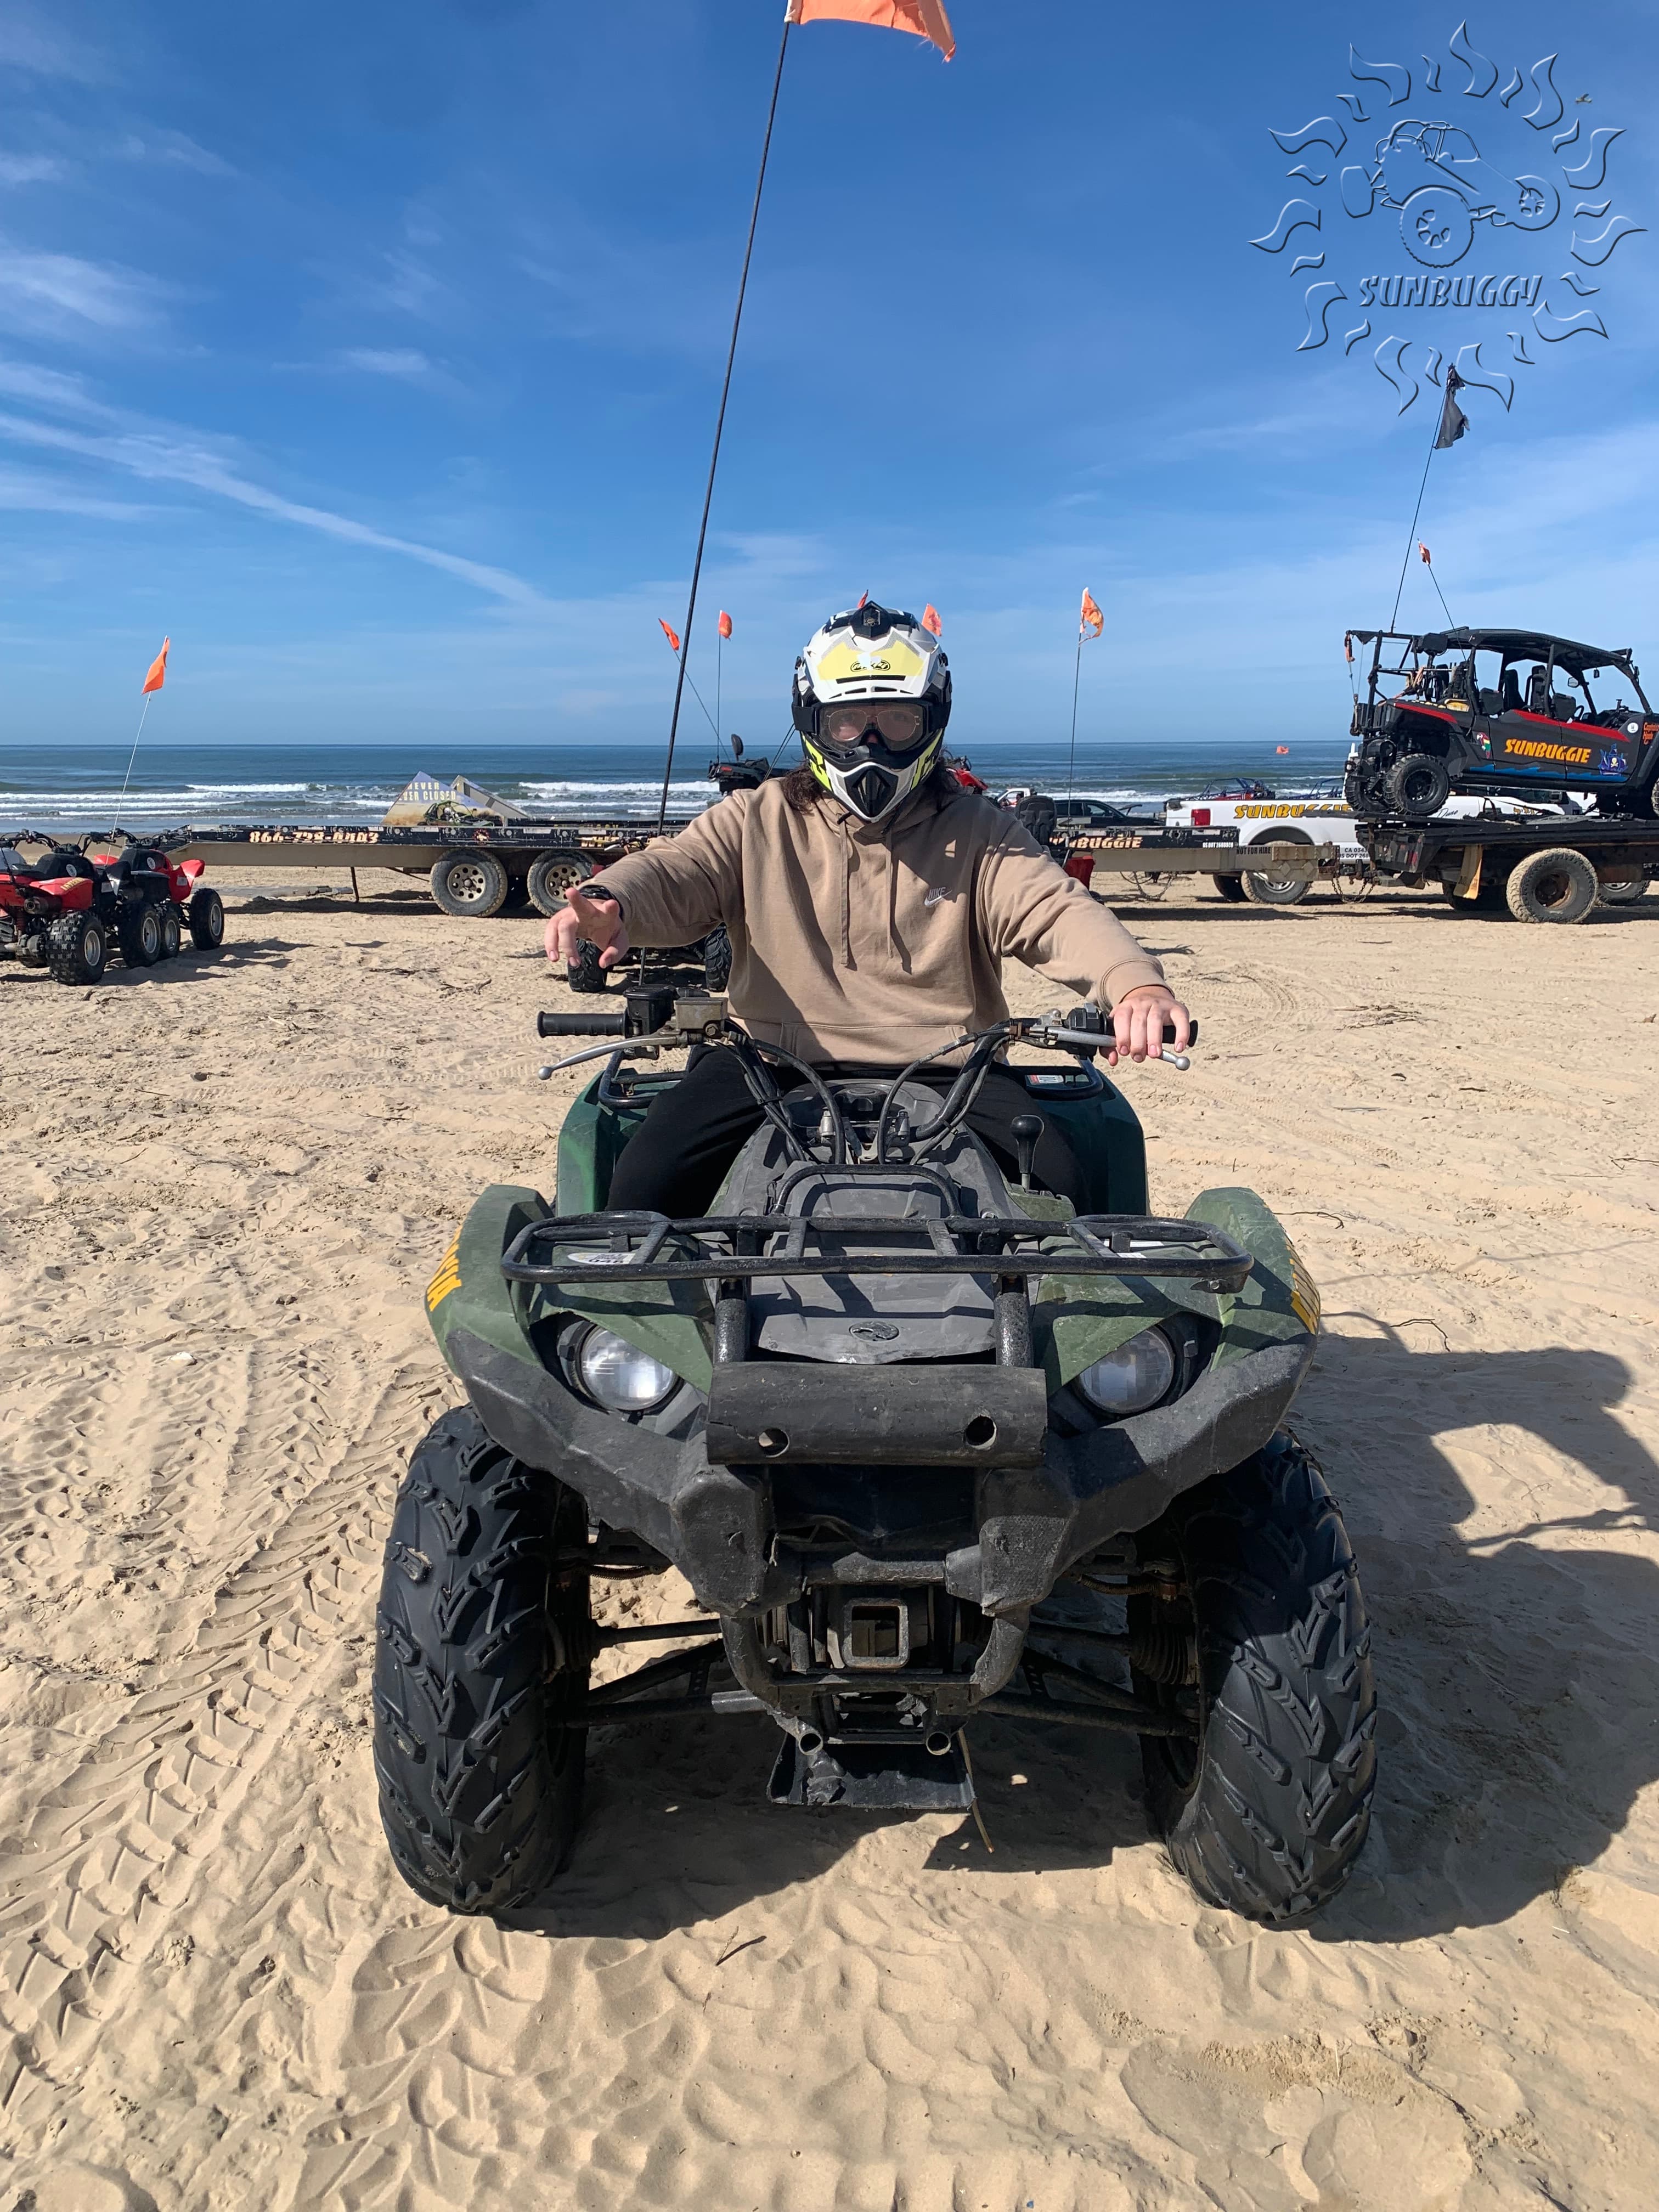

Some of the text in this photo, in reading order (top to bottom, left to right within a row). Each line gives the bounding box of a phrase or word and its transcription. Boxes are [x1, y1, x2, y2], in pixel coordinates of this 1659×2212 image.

[1503, 738, 1592, 763] SUNBUGGIE
[423, 791, 456, 800] CLOSED
[1049, 837, 1143, 848] BUGGIE
[928, 887, 946, 900] NIKE
